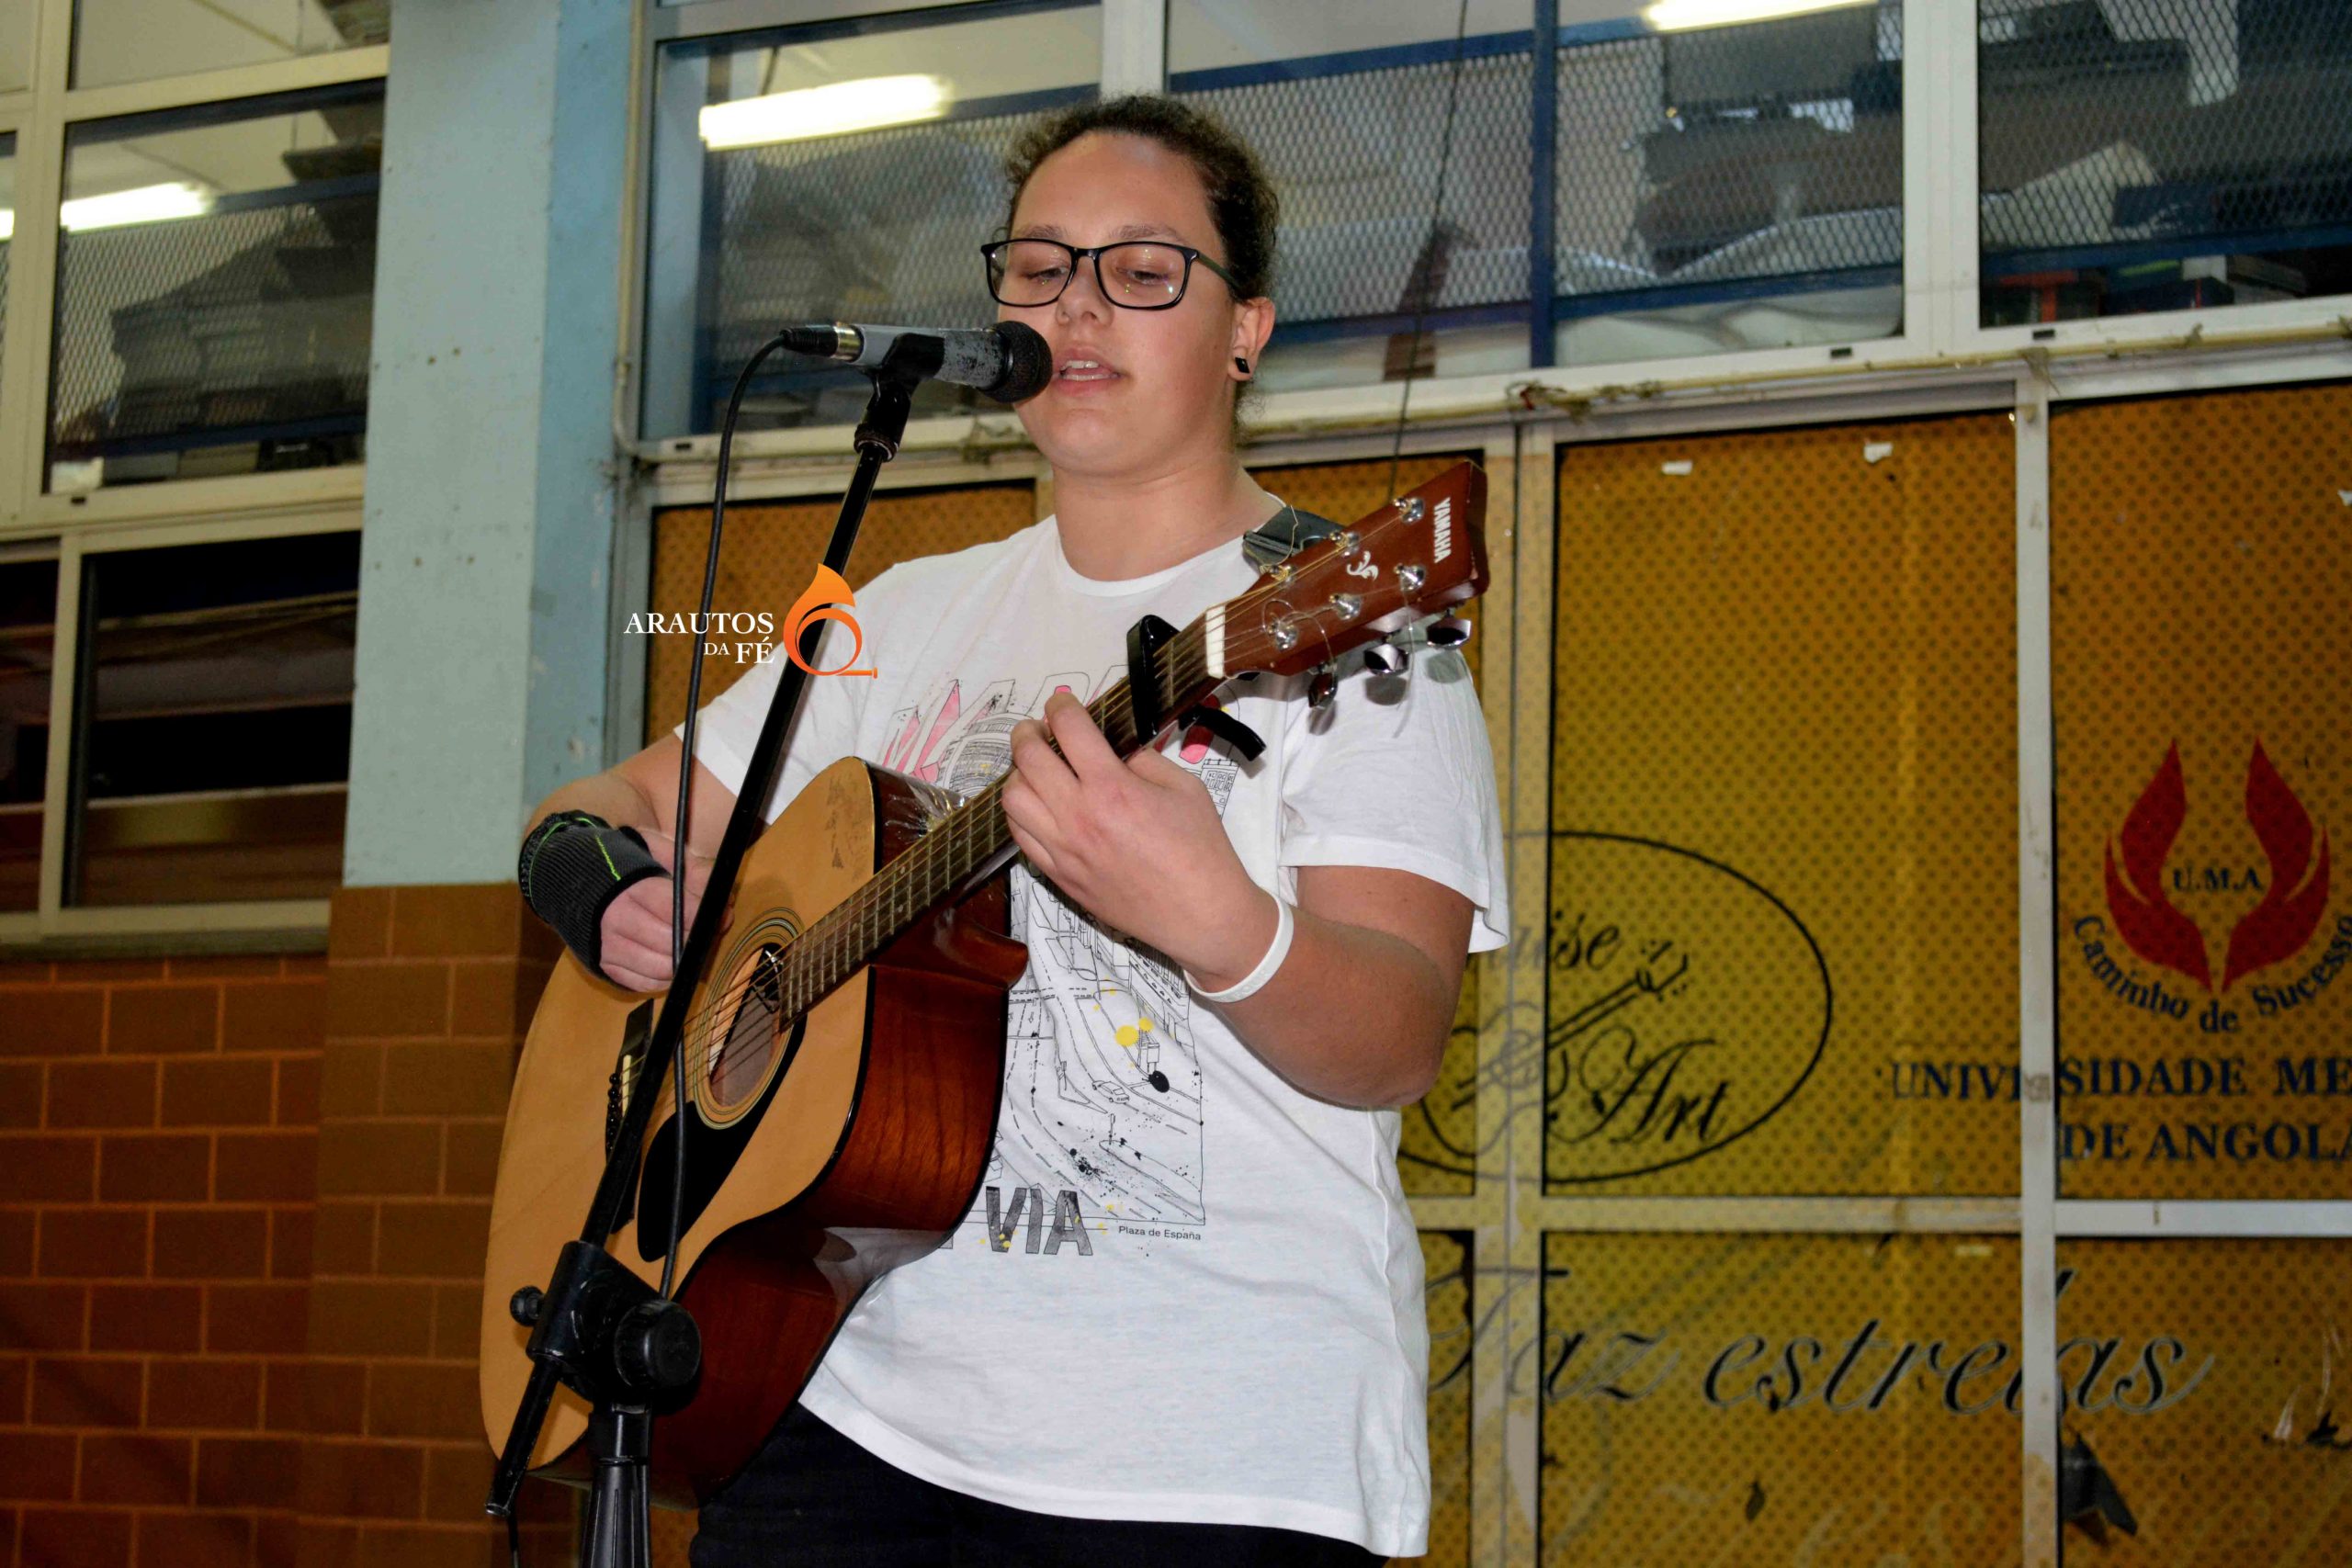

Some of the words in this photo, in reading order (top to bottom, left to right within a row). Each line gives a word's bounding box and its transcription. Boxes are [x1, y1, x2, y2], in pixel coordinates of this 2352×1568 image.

[1434, 497, 1452, 563] YAMAHA
[2074, 915, 2190, 1021] Caminho
[2199, 998, 2240, 1033] de
[1893, 1058, 2247, 1100] UNIVSIDADE
[2063, 1122, 2130, 1160] DE
[986, 1186, 1093, 1256] VIA
[1119, 1225, 1146, 1236] Plaza
[1148, 1228, 1161, 1237] de
[1164, 1229, 1202, 1241] España
